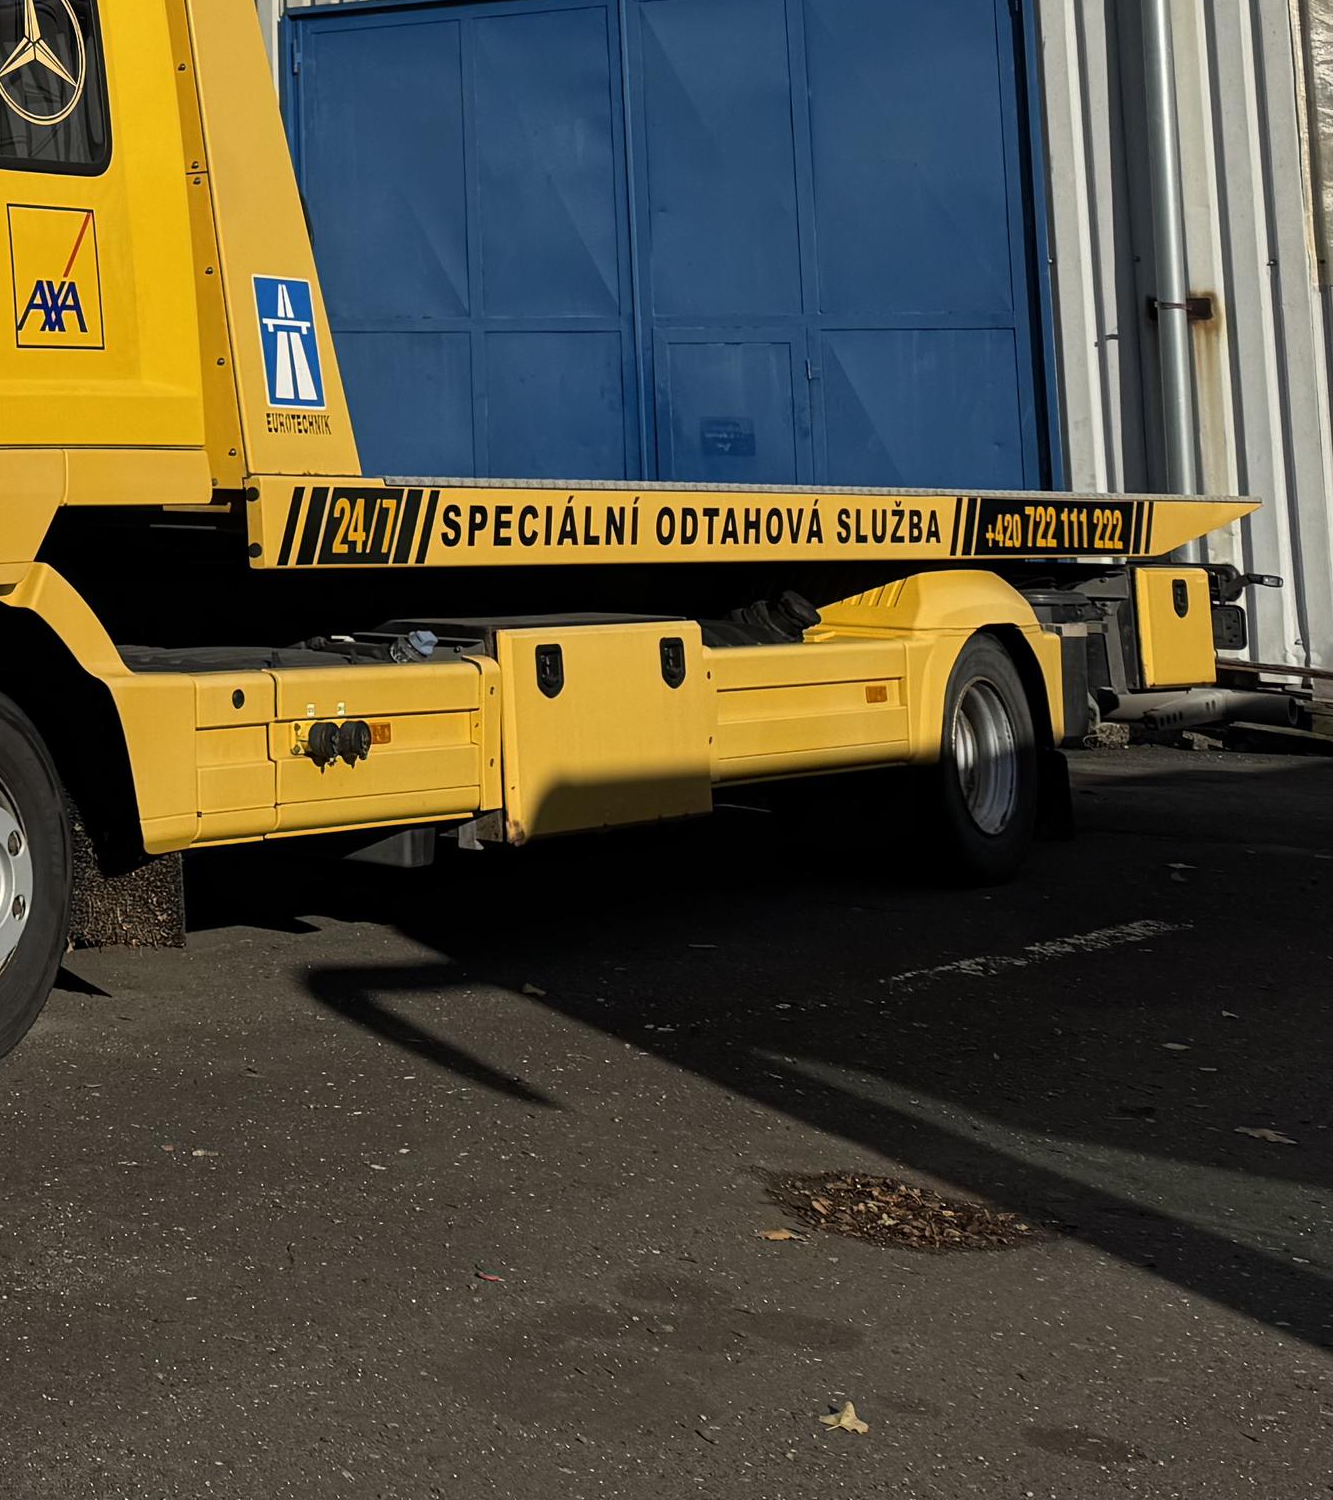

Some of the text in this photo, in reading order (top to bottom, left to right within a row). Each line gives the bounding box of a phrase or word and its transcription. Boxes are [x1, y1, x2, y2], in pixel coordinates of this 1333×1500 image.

[17, 280, 88, 333] AXA
[266, 412, 332, 435] EUROTECHNIK
[332, 495, 1123, 554] 24/7 SPECIÁLNÍ ODTAHOVÁ SLUŽBA +420 722 111 222
